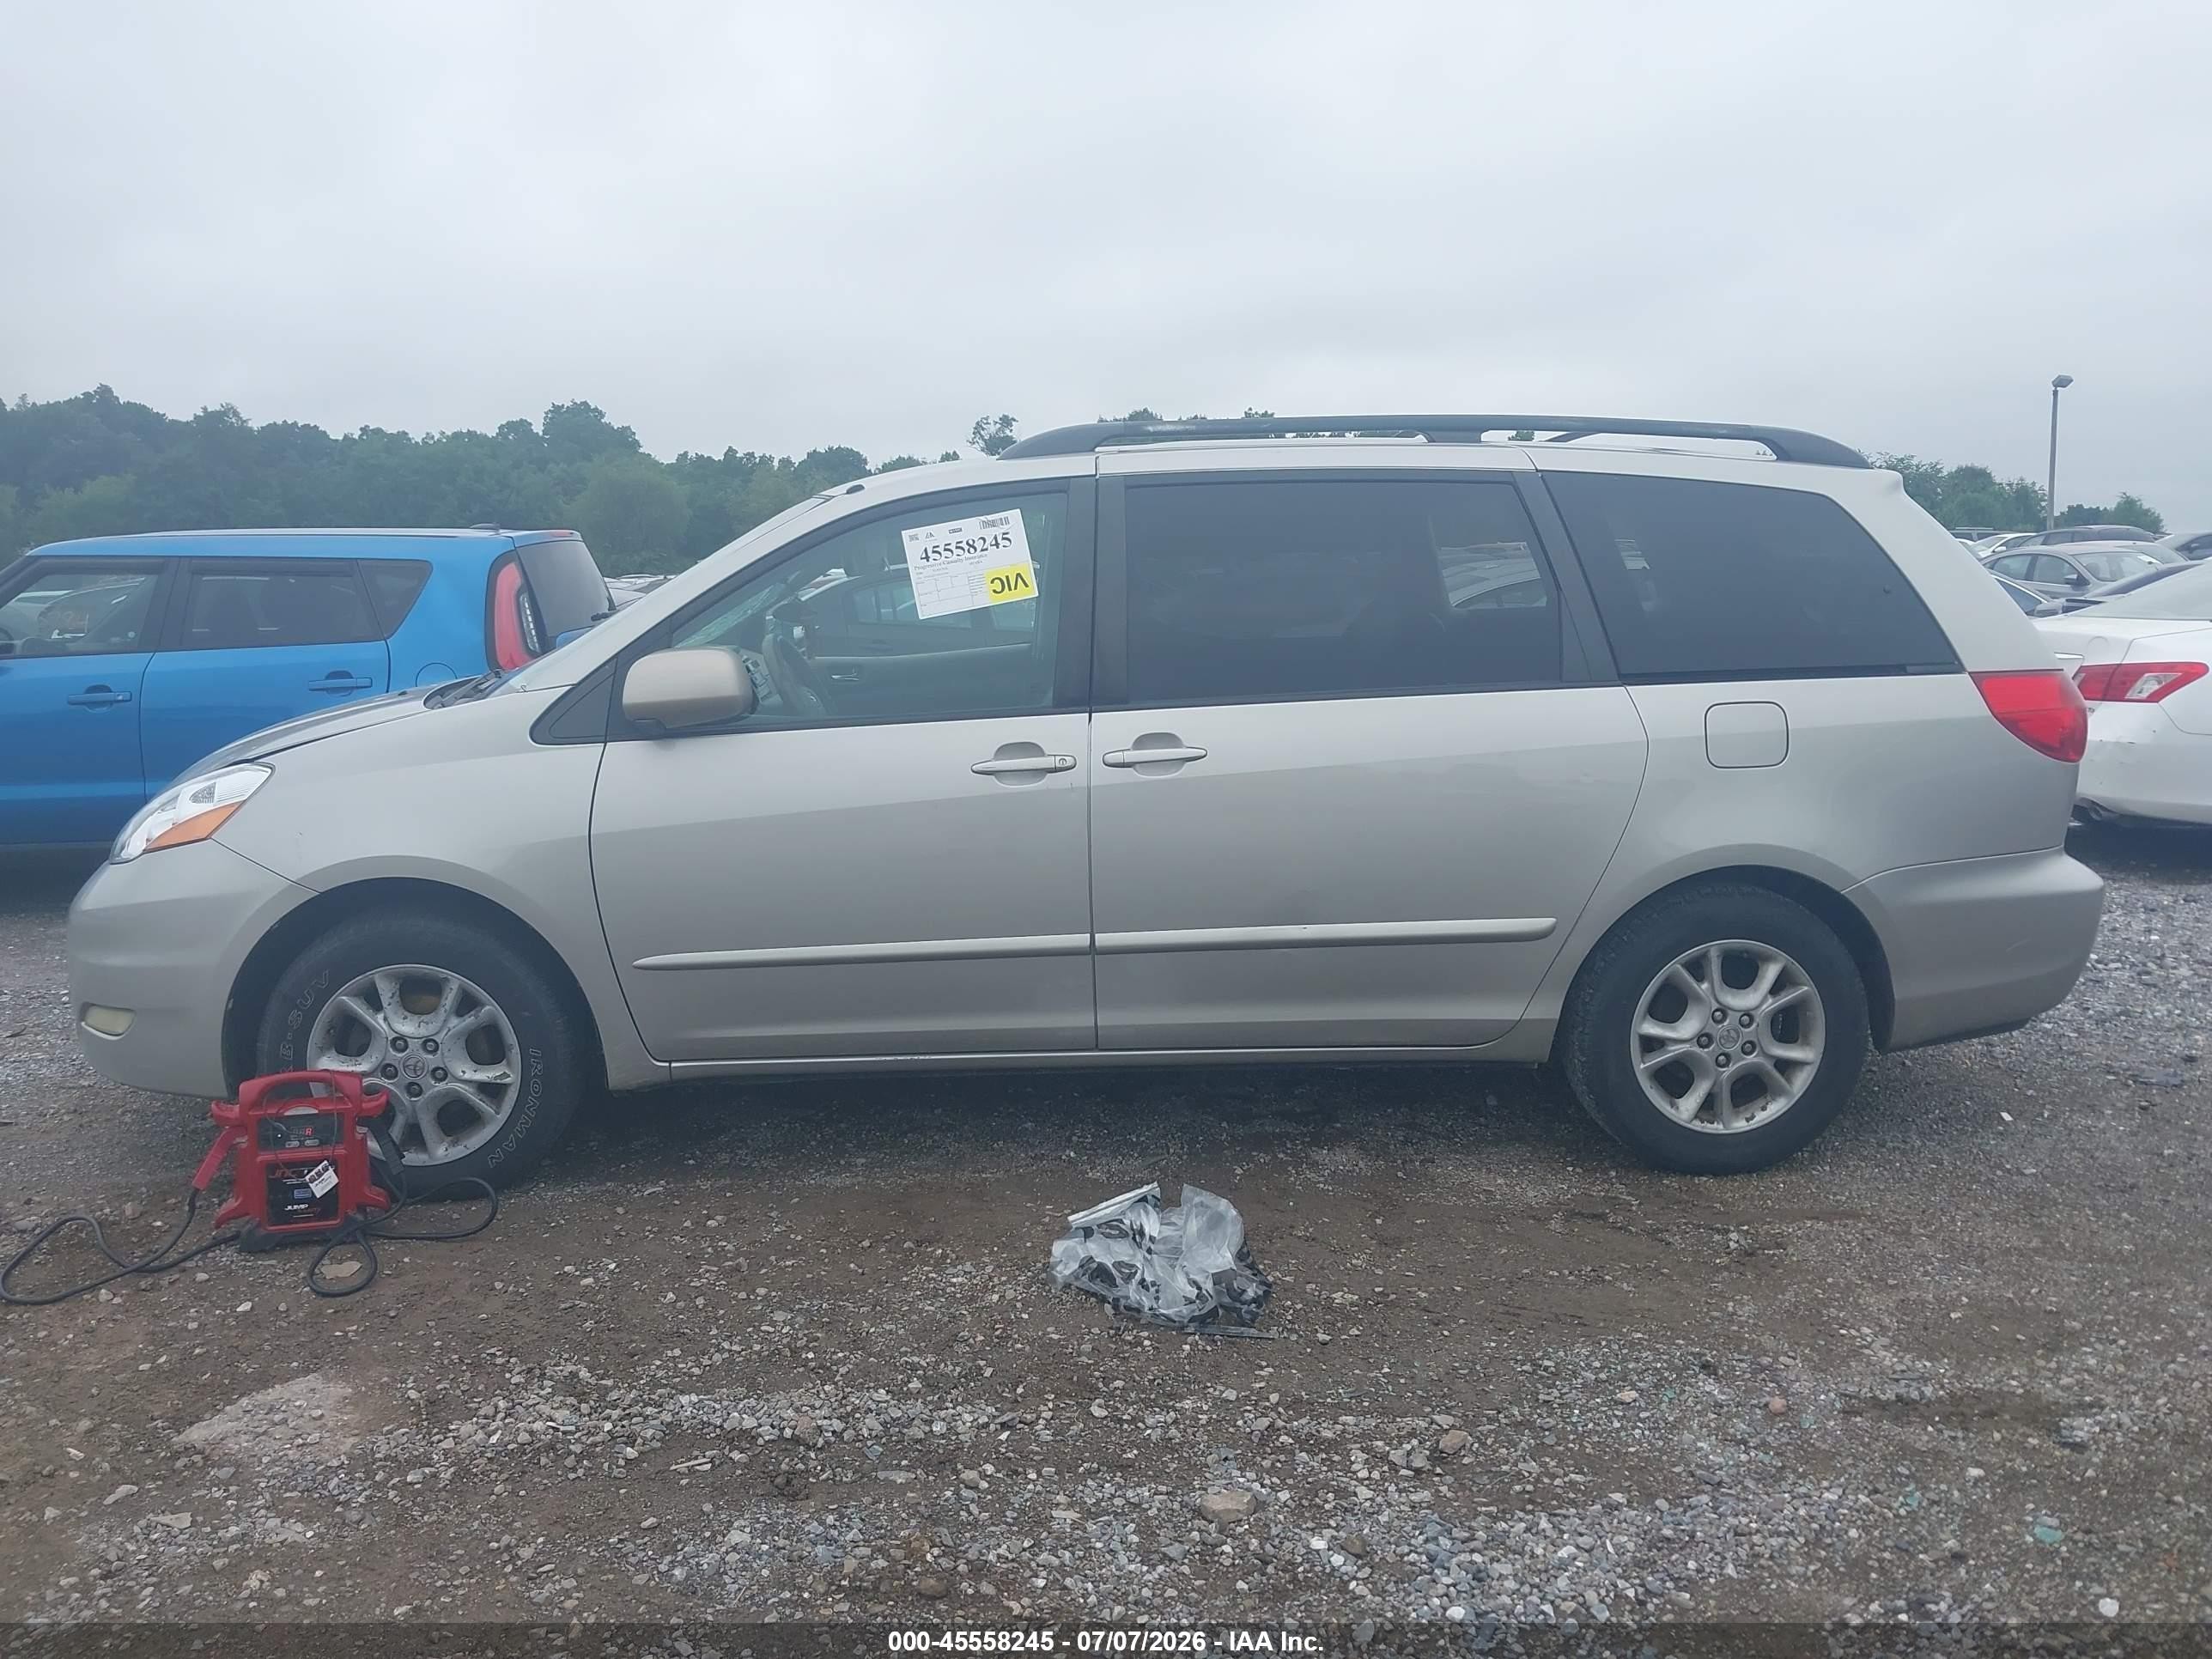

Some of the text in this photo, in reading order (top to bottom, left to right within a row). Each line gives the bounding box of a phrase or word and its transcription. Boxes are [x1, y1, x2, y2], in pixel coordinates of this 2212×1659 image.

[920, 532, 1012, 562] 45558245
[990, 572, 1030, 594] VIC
[487, 1045, 544, 1169] IRONMAN
